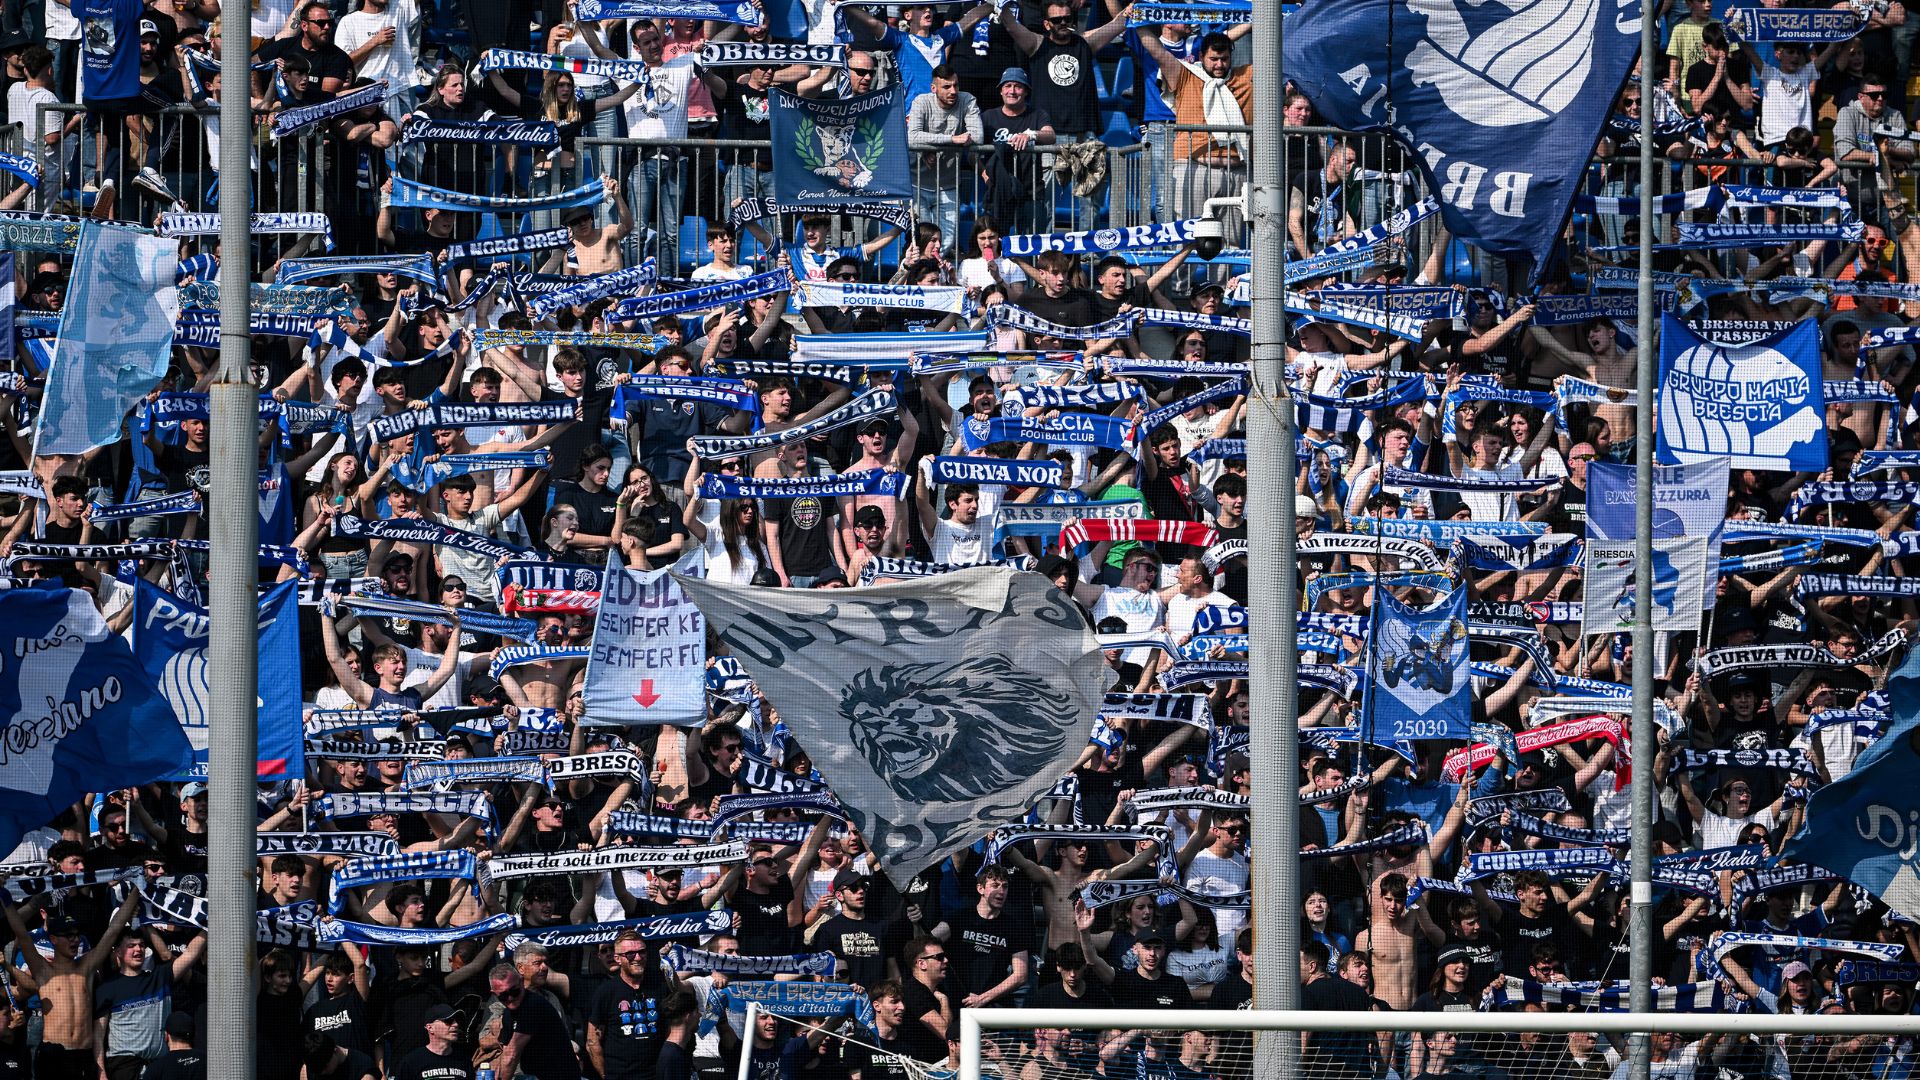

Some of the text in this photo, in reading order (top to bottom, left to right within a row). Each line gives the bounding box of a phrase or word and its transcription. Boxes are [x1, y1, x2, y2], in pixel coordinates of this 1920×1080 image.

[1145, 8, 1193, 21] FORZA
[1759, 12, 1811, 29] FORZA
[1776, 29, 1822, 39] Leonessa
[778, 95, 804, 110] ANY
[846, 95, 892, 115] SUNDAY
[408, 121, 552, 142] Leonessa d' Italia
[415, 186, 482, 206] Forza
[797, 187, 888, 199] Curva Nord Brescia
[1008, 218, 1198, 254] ULT RAS
[1706, 224, 1838, 238] CURVA NORD
[469, 238, 518, 255] NORD
[842, 283, 925, 297] BRESCIA
[842, 296, 926, 309] FOOTBALL CLUB
[1145, 308, 1210, 326] URVA
[1554, 311, 1602, 322] Leonessa
[1701, 320, 1769, 331] BRESCIA
[736, 362, 851, 383] BRESCIA
[640, 387, 739, 402] BRESCIA
[1669, 370, 1810, 401] GRUPPO MANIA
[377, 401, 574, 437] CURVA NORD BRESCIA
[1693, 399, 1784, 421] BRESCIA
[1020, 430, 1095, 442] FOOTBALL CLUB
[940, 461, 1011, 481] CURVA
[739, 482, 866, 496] SI PASSEGGIA
[1373, 521, 1431, 537] FORZA
[364, 519, 441, 543] Leonessa
[463, 534, 516, 559] Italia
[1324, 534, 1381, 552] mezzo
[1385, 540, 1404, 552] ai
[1406, 541, 1441, 571] guai
[1466, 542, 1516, 562] BRESCIA
[1593, 549, 1636, 559] BRESCIA
[511, 566, 569, 590] ULT
[1847, 576, 1897, 592] NORD
[599, 611, 669, 637] SEMPER
[597, 645, 672, 669] SEMPER
[1705, 646, 1776, 669] CURVA
[1393, 719, 1448, 738] 25030
[322, 740, 382, 755] NORD
[336, 795, 490, 813] BRESCIA
[1184, 788, 1207, 803] da
[493, 845, 744, 874] ...mai da soli in mezzo ai guai...
[1477, 851, 1612, 869] CURVA NORD
[1704, 849, 1756, 869] Italia
[372, 866, 424, 879] ULTRAS
[538, 915, 704, 948] Leonessa Italia
[962, 930, 1006, 948] BRESCIA
[690, 954, 796, 971] BRESCIA
[797, 1002, 842, 1015] d'Italia
[314, 1010, 351, 1029] BRESCIA
[422, 1069, 467, 1078] CURVA NORD
